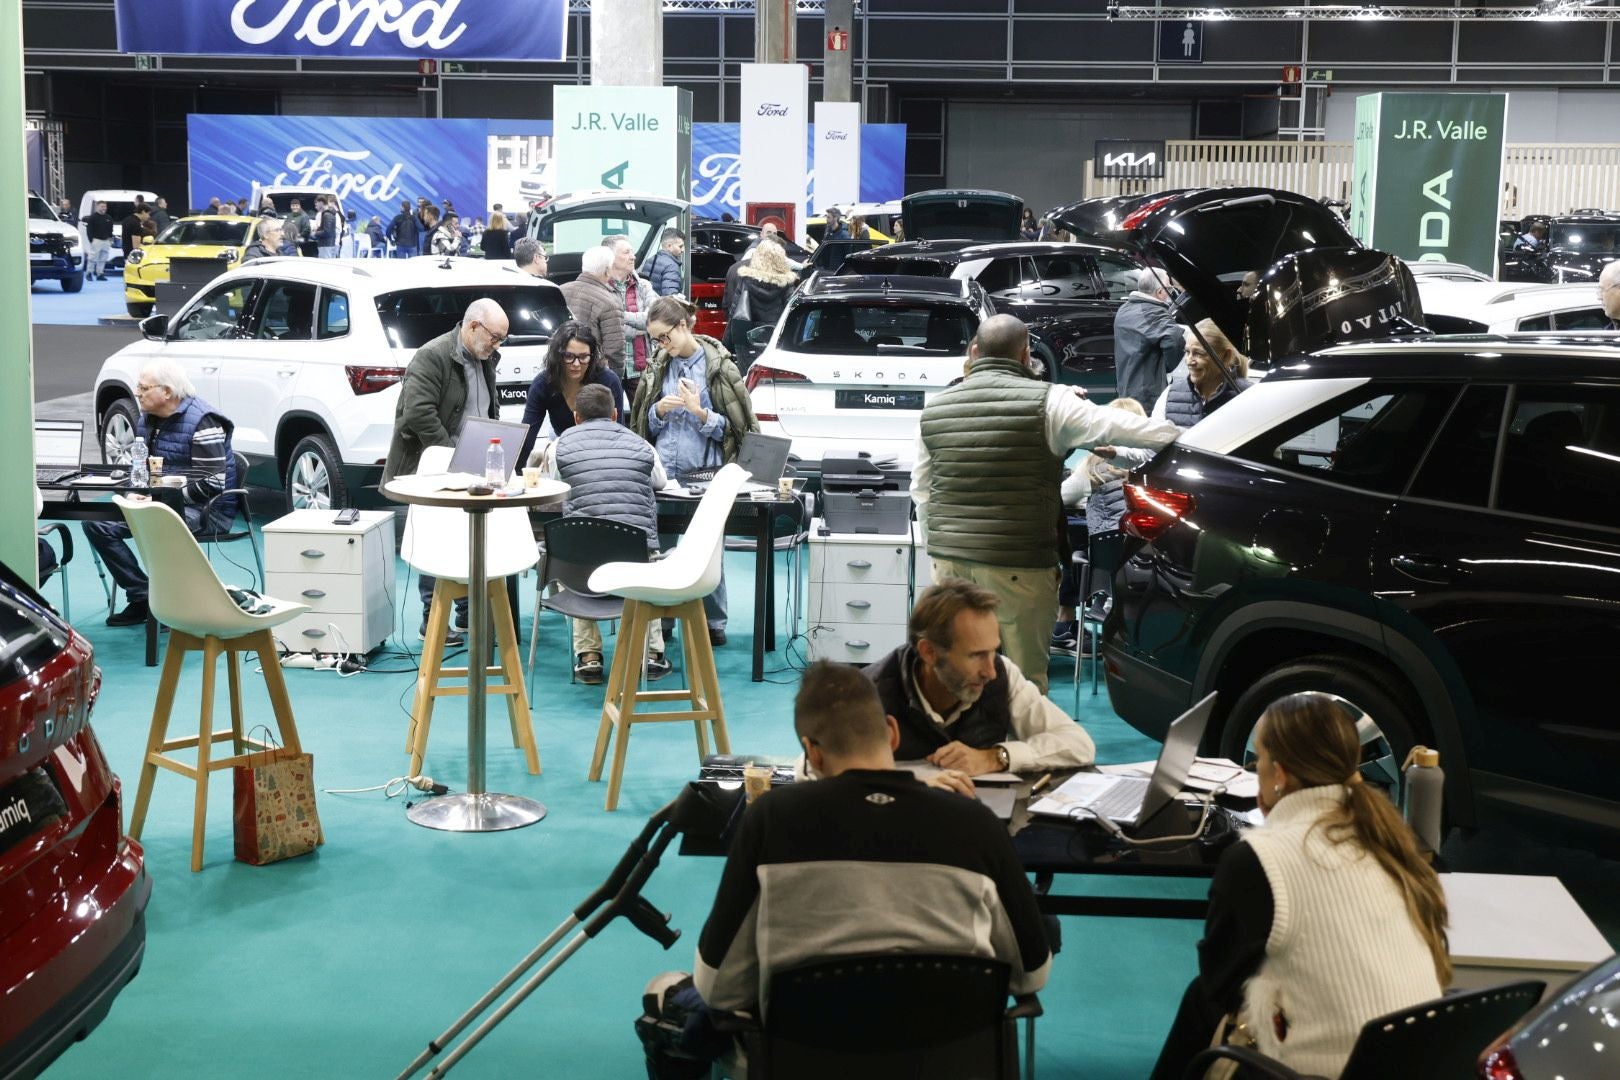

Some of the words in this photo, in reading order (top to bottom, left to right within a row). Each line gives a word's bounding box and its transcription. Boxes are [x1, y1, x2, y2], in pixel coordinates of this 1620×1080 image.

[757, 103, 789, 116] Ford
[571, 112, 607, 131] J.R.
[611, 112, 659, 131] Valle
[825, 130, 847, 140] Ford
[1394, 120, 1432, 139] J.R.
[1437, 120, 1488, 140] Valle
[273, 146, 403, 202] Ford
[500, 389, 527, 400] Karoq
[864, 393, 896, 406] Kamiq
